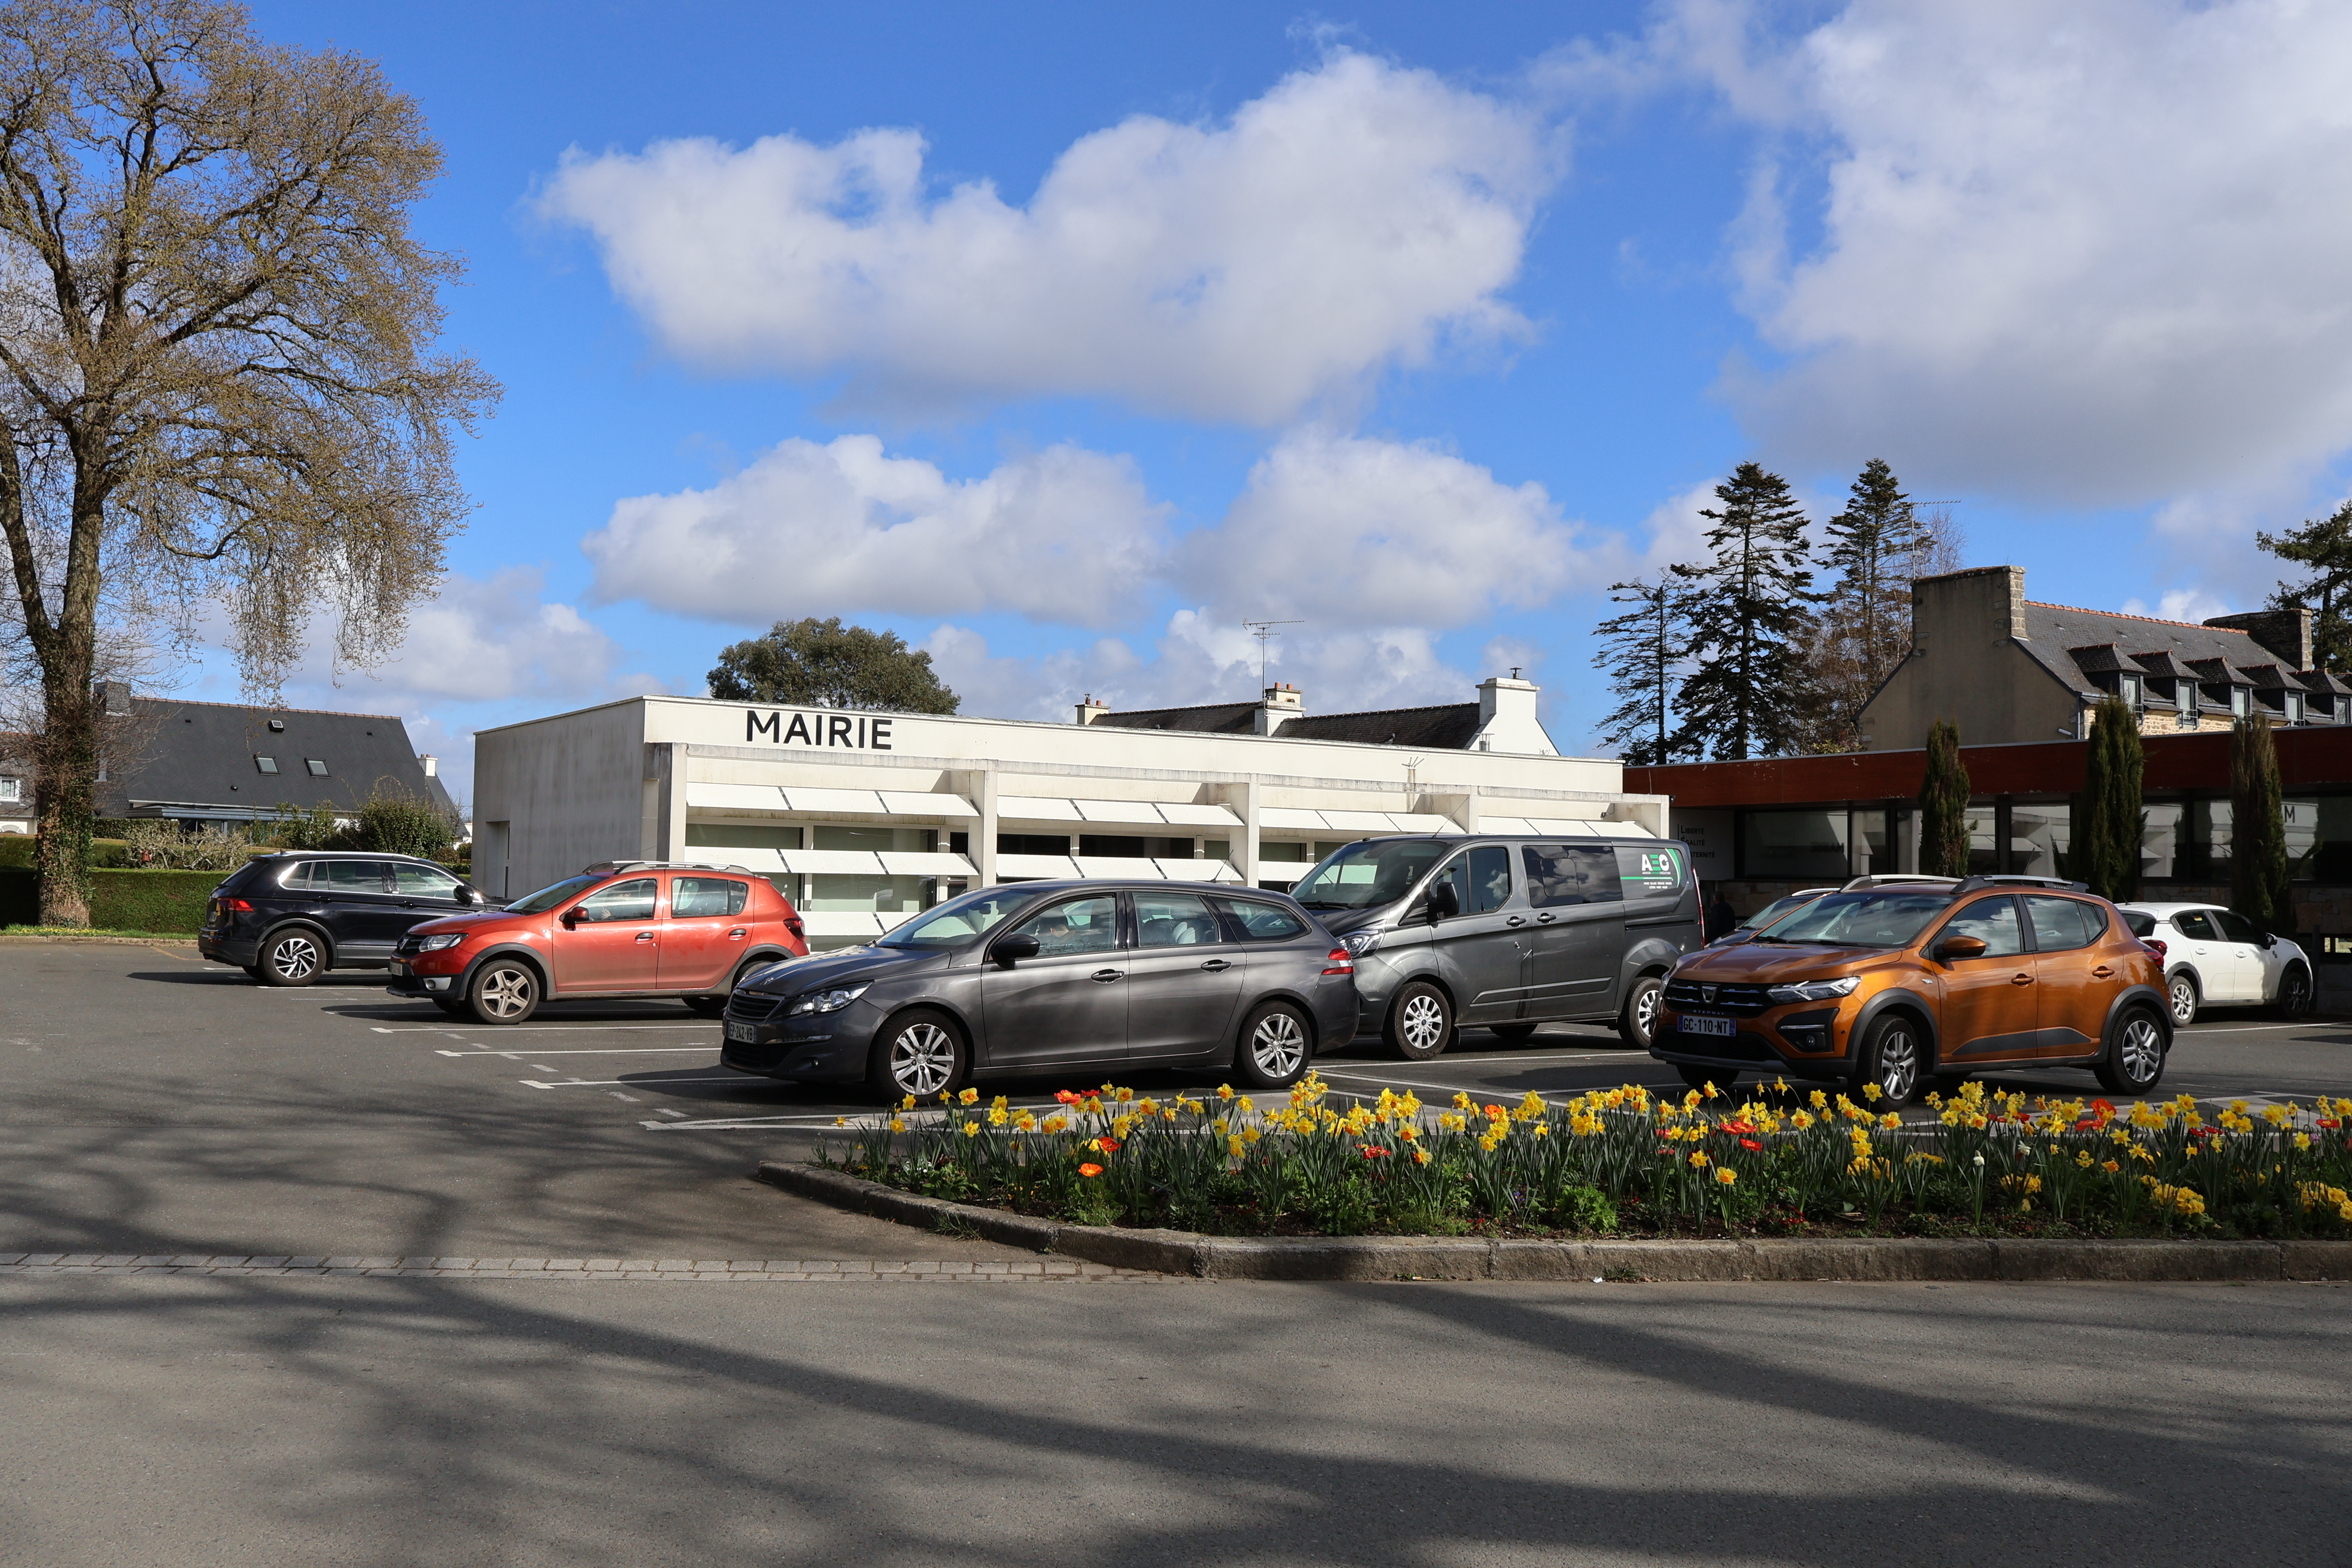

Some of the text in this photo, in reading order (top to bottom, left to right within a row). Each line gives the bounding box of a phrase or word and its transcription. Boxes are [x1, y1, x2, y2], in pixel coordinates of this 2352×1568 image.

[746, 710, 892, 750] MAIRIE
[1681, 825, 1704, 834] LIBERTÉ
[1681, 835, 1706, 846] ÉGALITÉ
[1683, 1018, 1728, 1034] GC-110-NT
